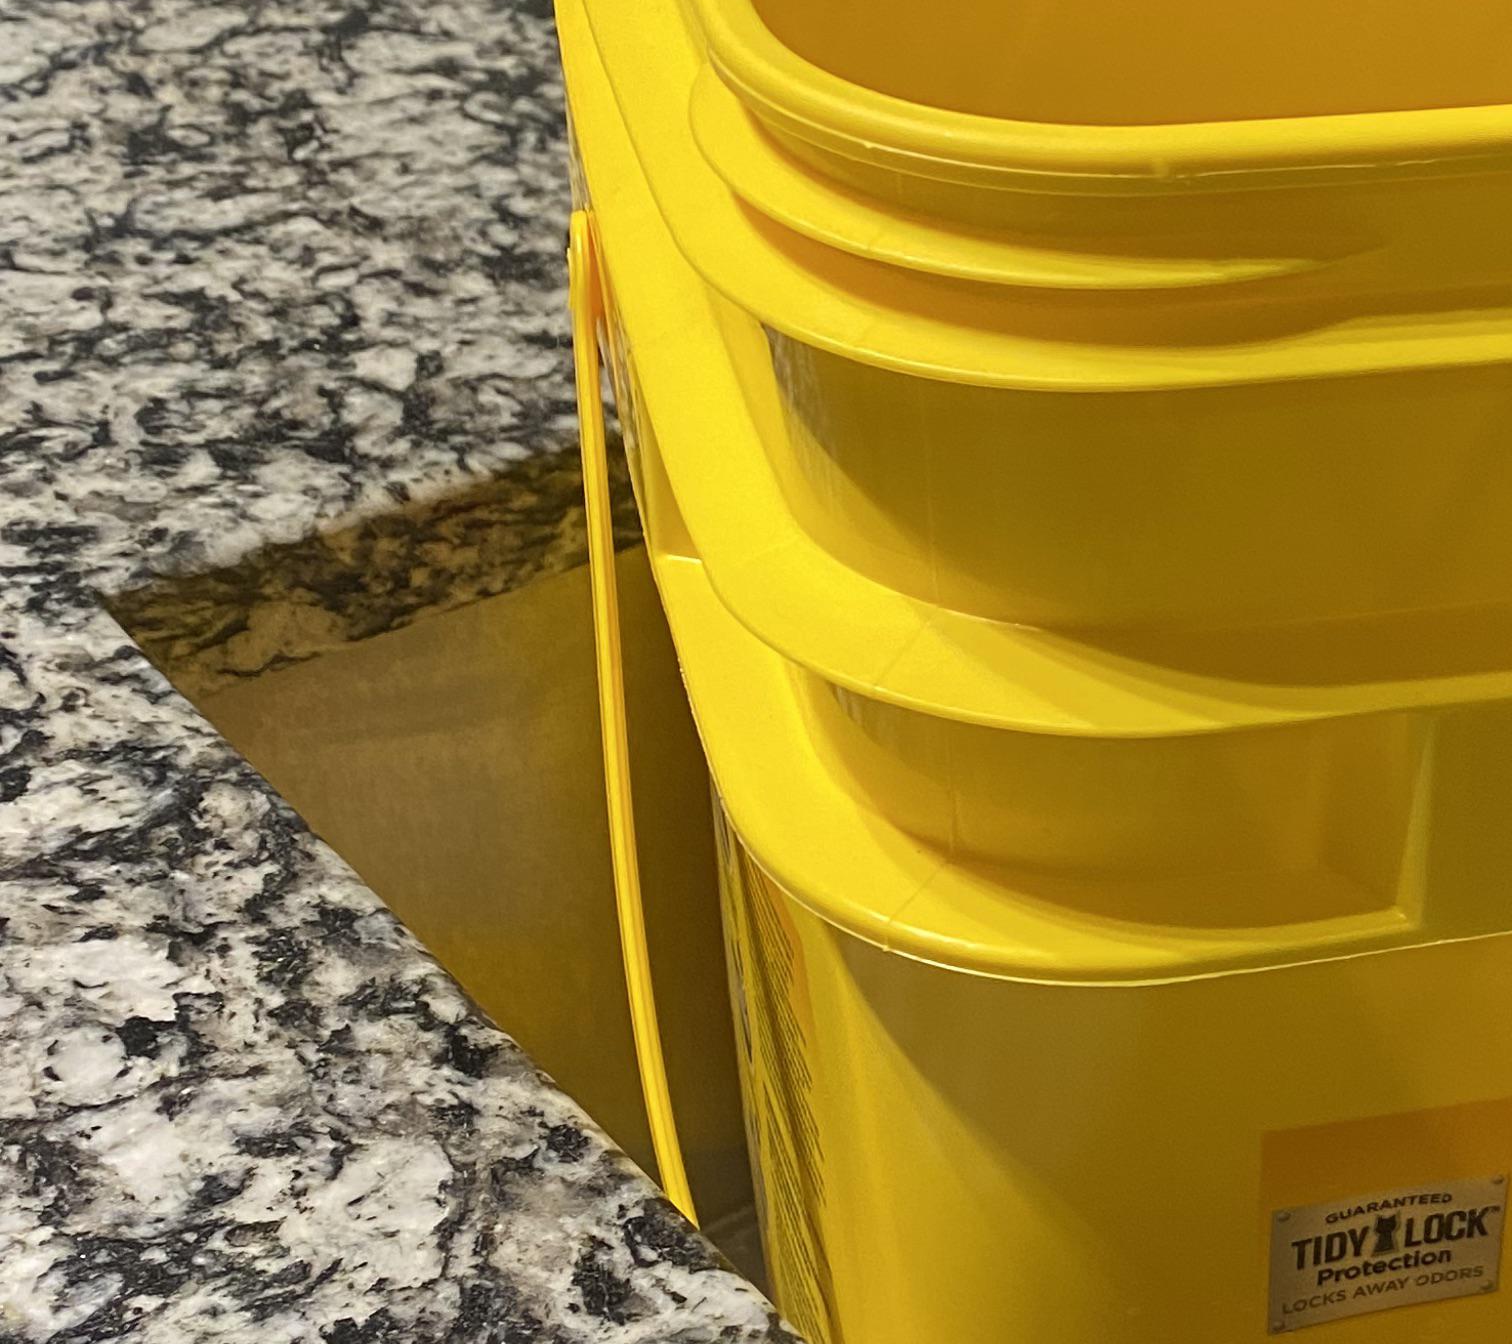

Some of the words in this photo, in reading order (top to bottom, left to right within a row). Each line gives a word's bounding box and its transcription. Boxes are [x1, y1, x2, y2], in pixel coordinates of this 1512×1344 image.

[1325, 1193, 1453, 1224] GUARANTEED
[1291, 1225, 1370, 1271] TIDY
[1404, 1206, 1490, 1248] LOCK
[1317, 1249, 1452, 1286] Protection
[1281, 1290, 1347, 1315] LOCKS
[1352, 1277, 1410, 1299] AWAY
[1415, 1265, 1485, 1287] ODORS
